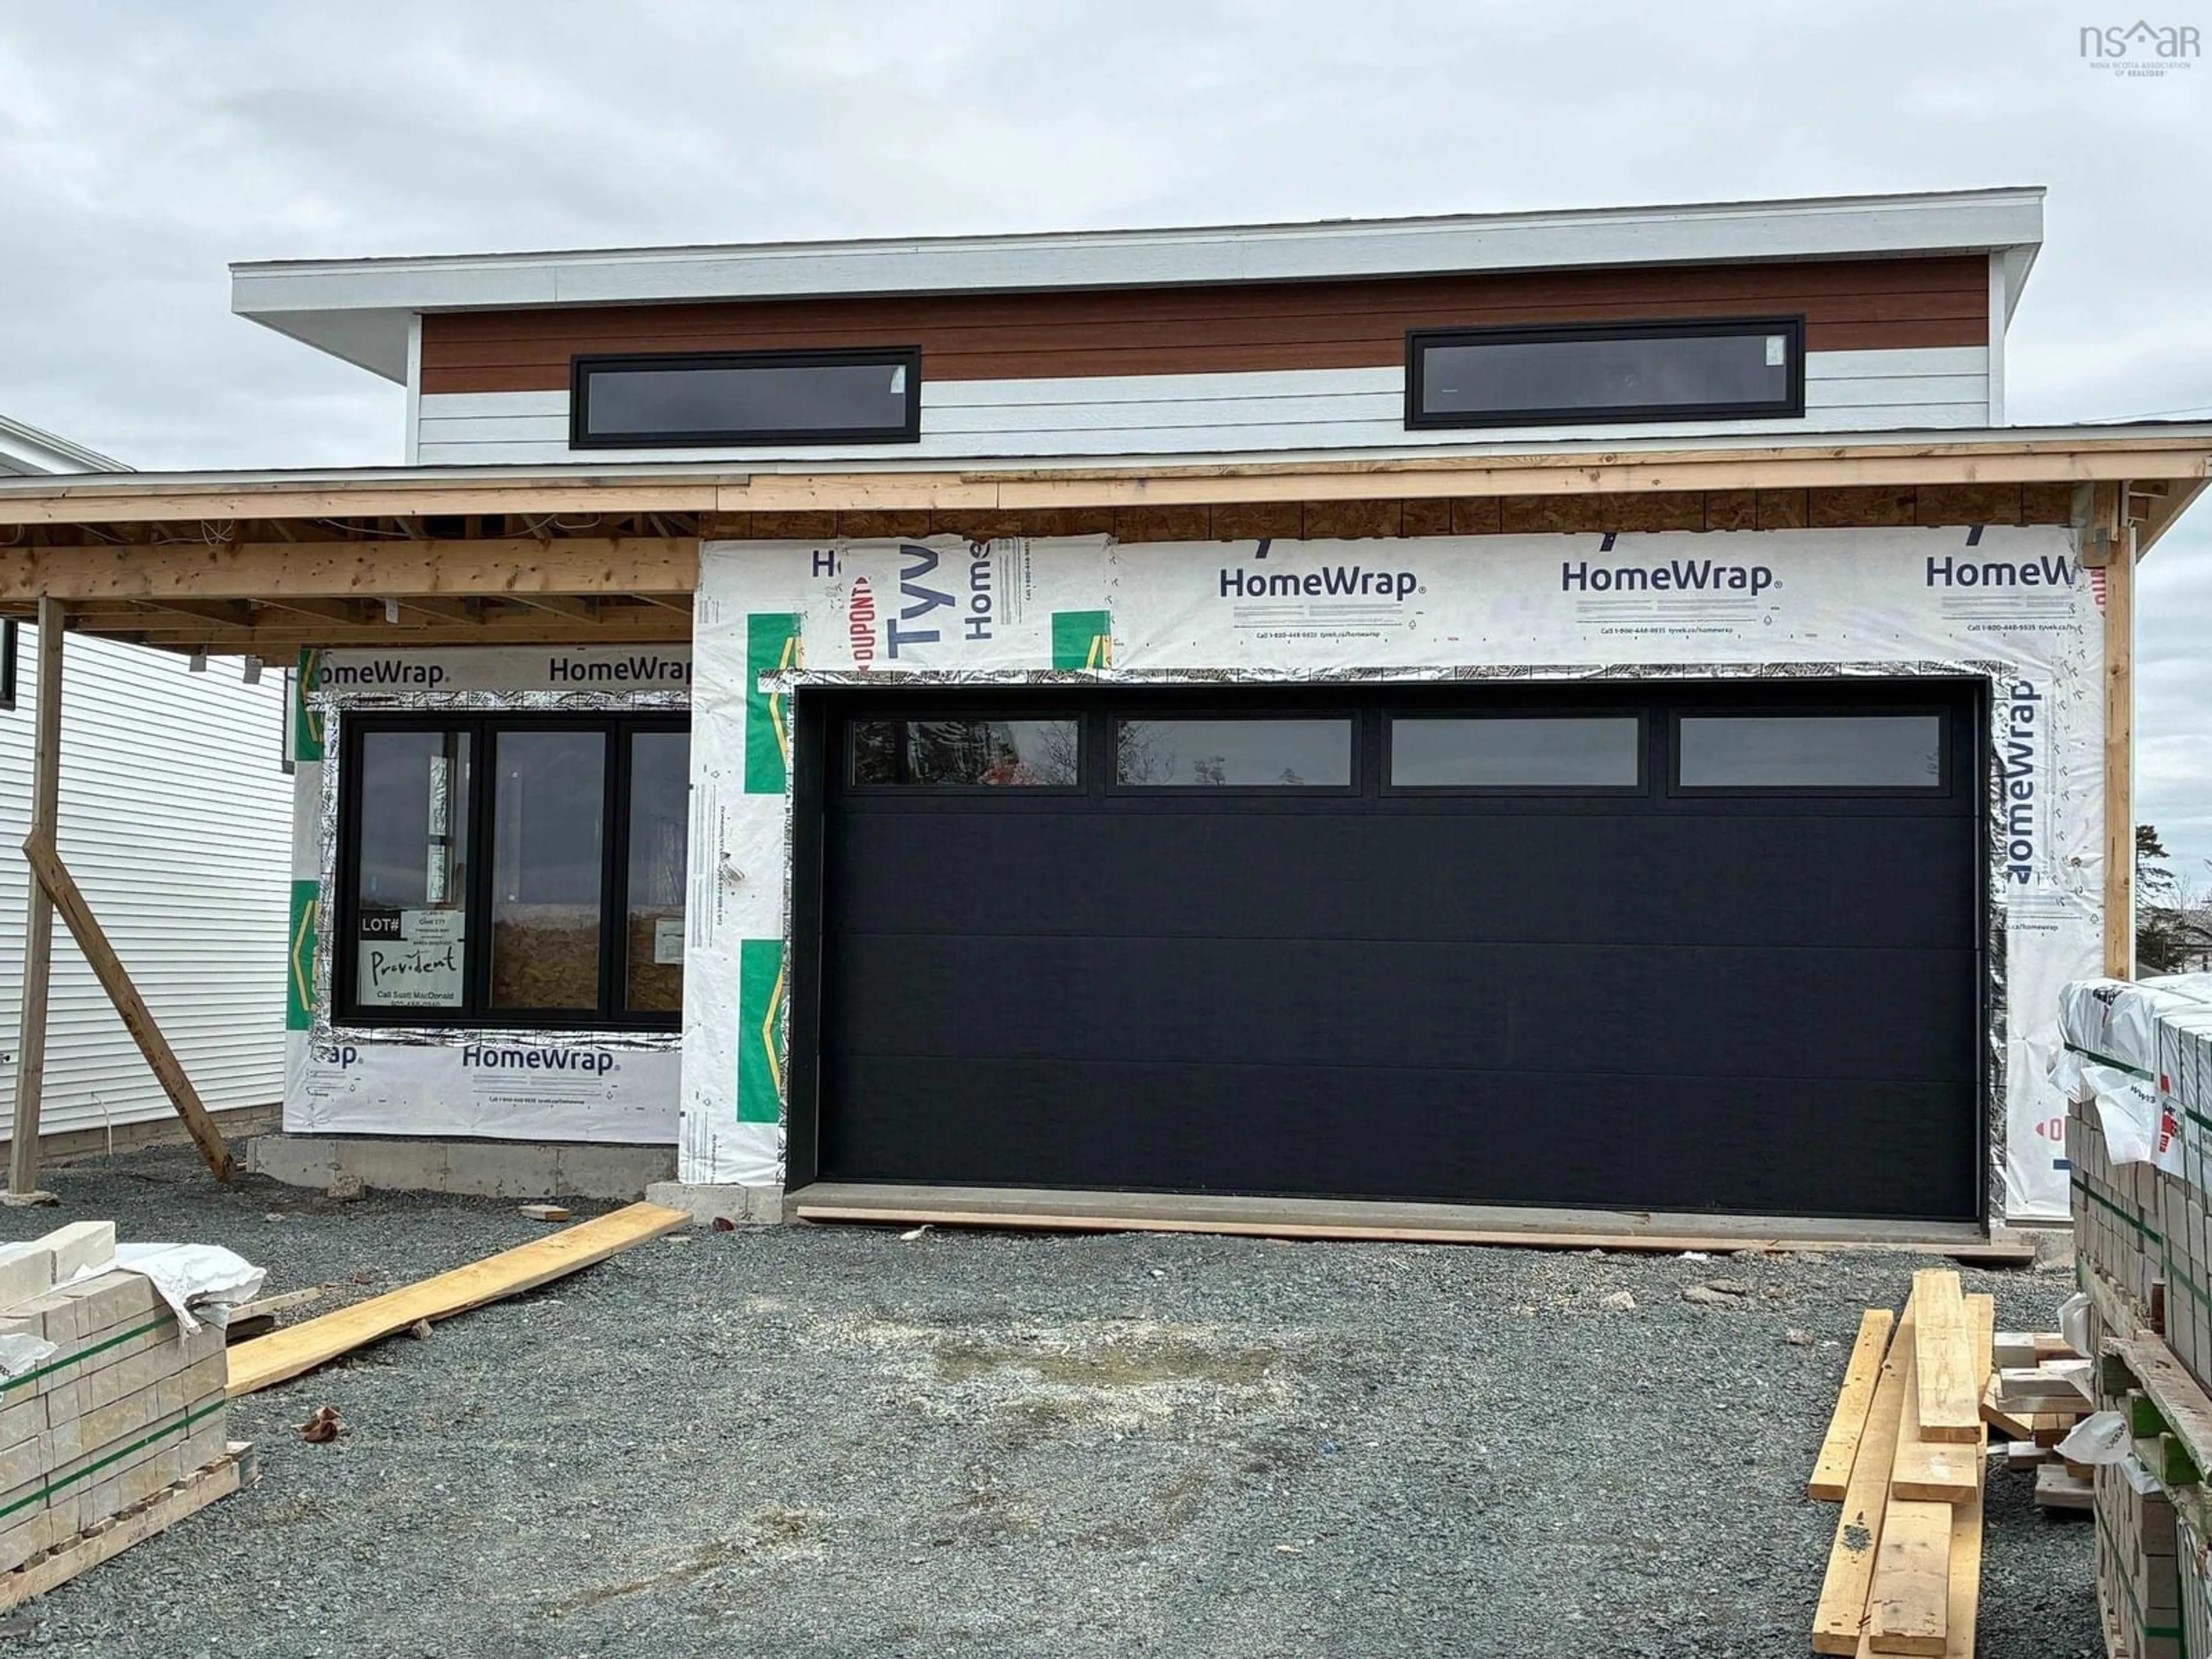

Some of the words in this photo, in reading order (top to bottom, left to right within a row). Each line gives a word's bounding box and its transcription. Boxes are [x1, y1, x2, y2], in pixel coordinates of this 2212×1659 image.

[849, 587, 876, 661] DUPONT
[362, 918, 399, 932] LOT#
[372, 946, 457, 986] Provident
